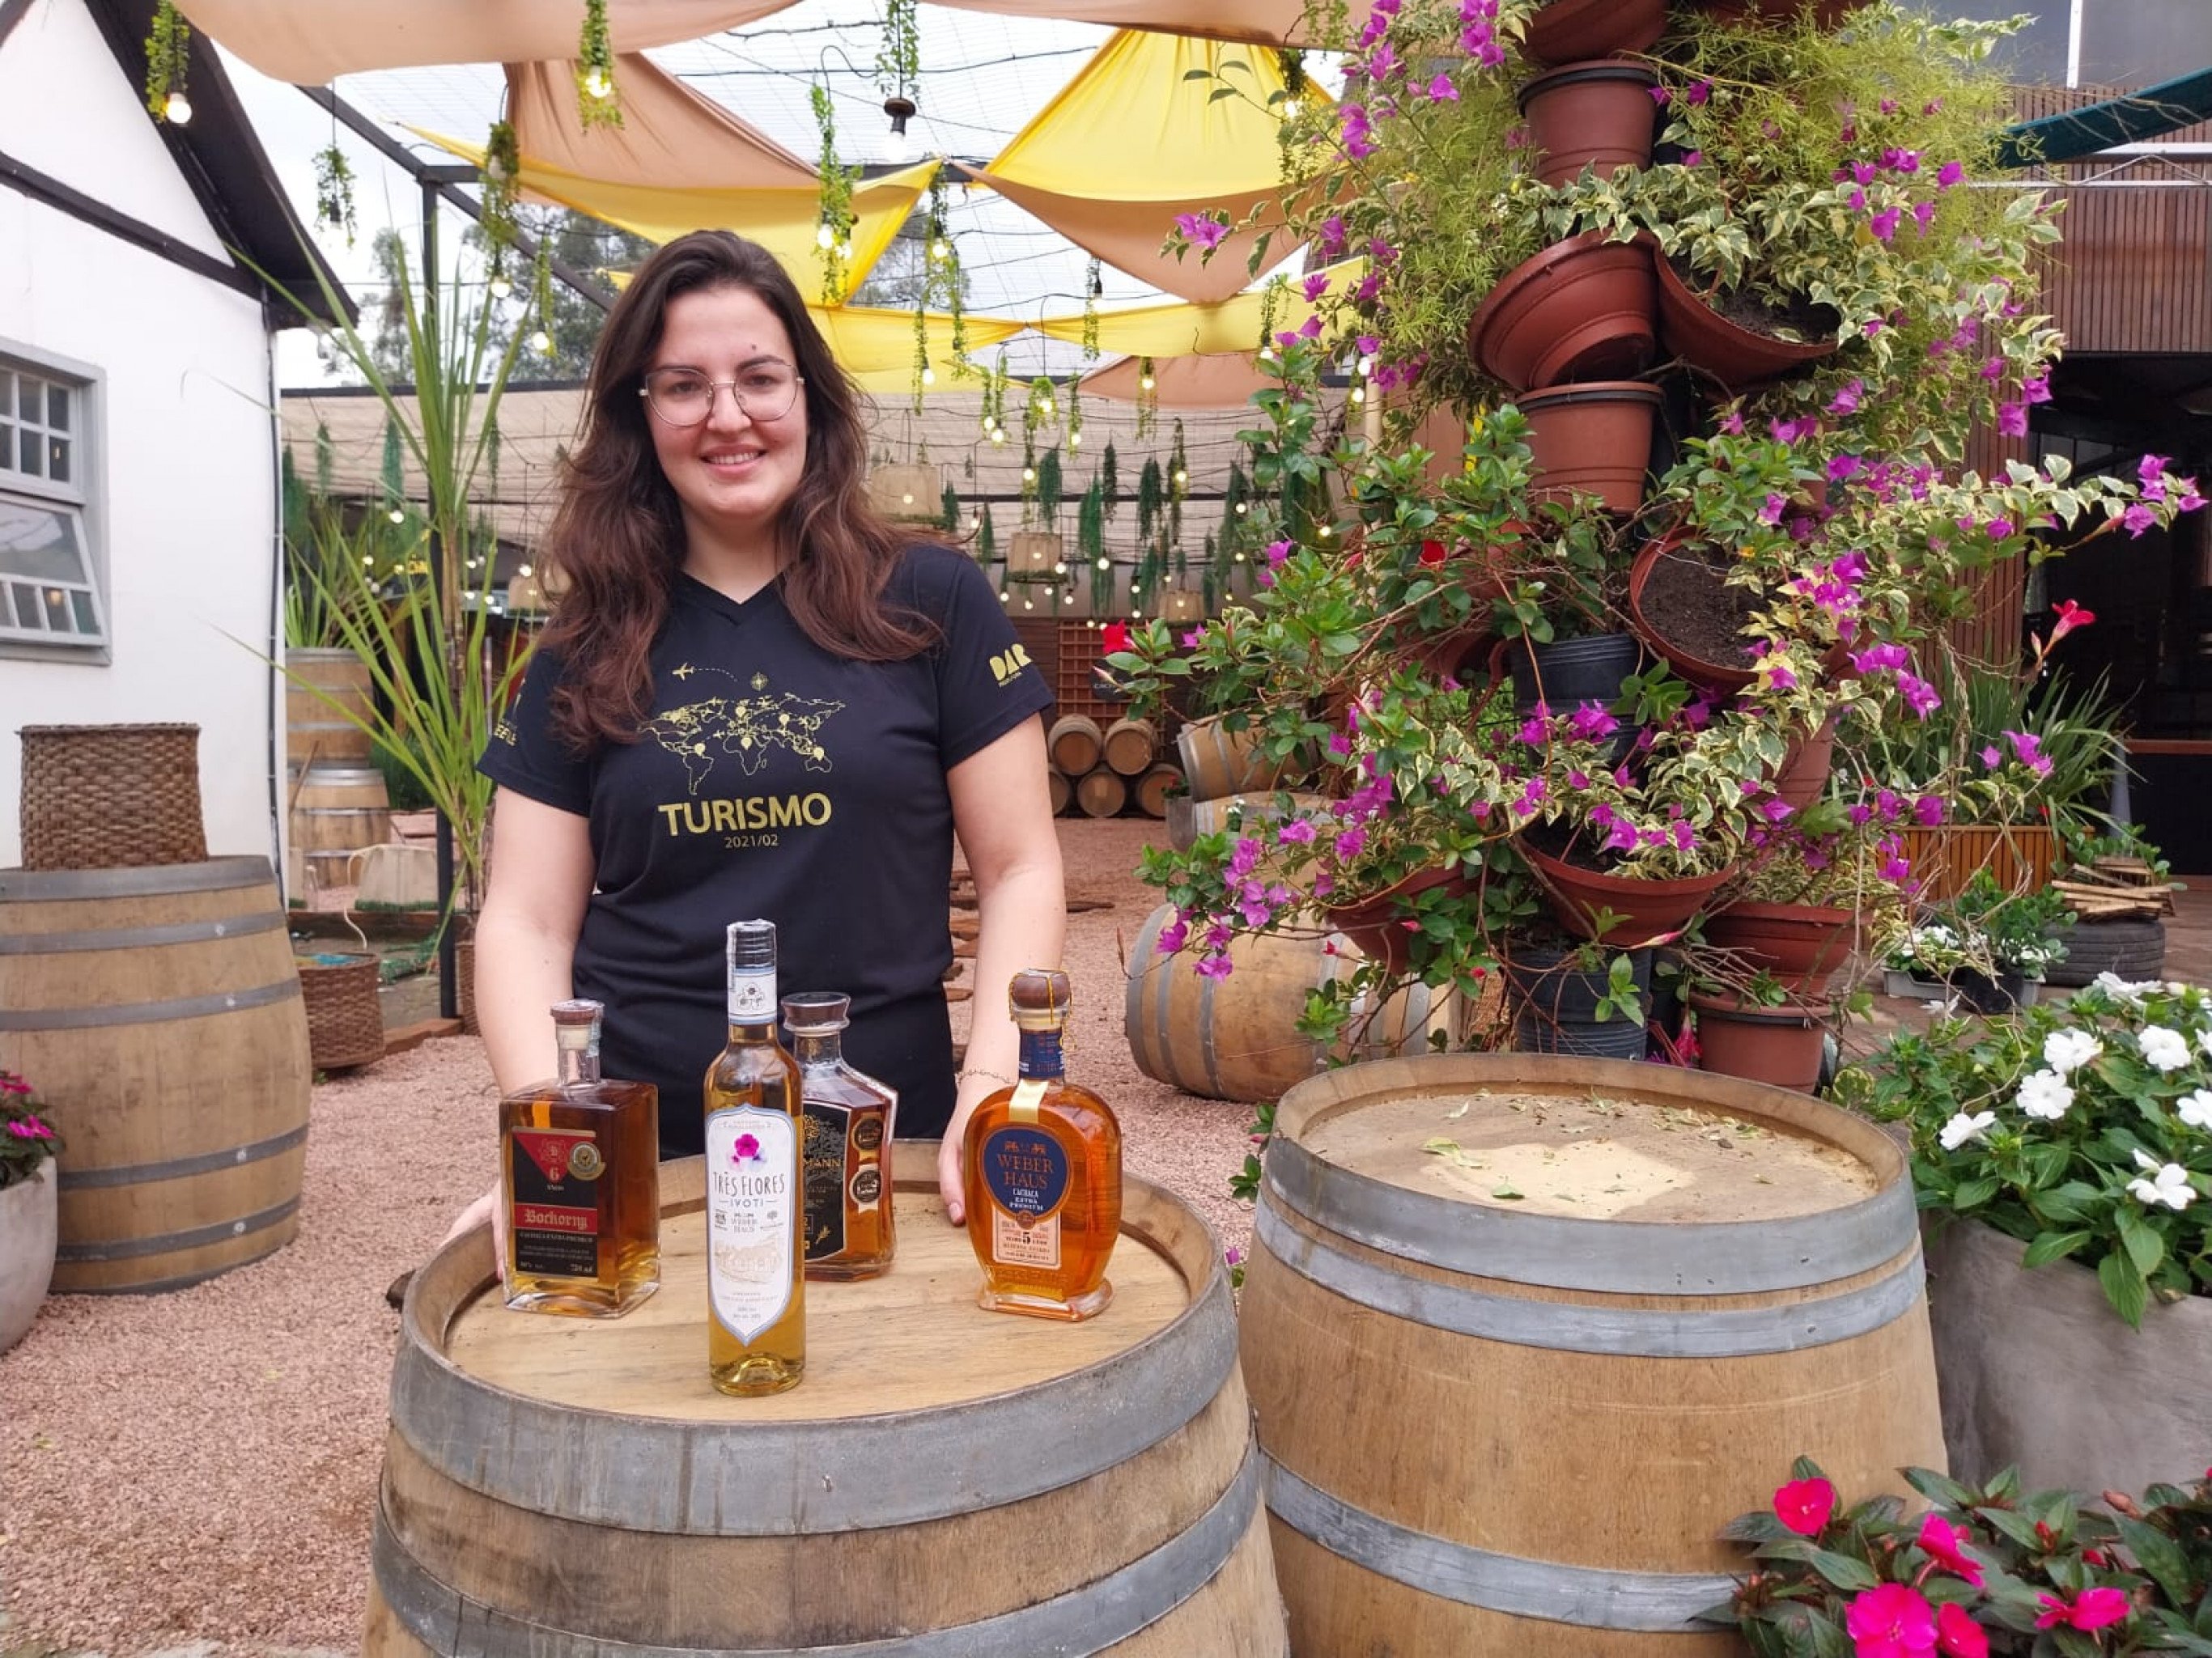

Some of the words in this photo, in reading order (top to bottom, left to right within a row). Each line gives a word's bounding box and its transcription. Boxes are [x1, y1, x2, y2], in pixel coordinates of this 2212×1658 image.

[657, 792, 833, 837] TURISMO
[724, 834, 779, 849] 2021/02
[997, 1153, 1053, 1173] WEBER
[550, 1167, 560, 1181] 6
[1003, 1171, 1048, 1189] HAUS
[713, 1171, 738, 1197] TRÊS
[741, 1172, 785, 1196] FLORES
[730, 1198, 764, 1208] IVOTI
[1022, 1232, 1031, 1245] 5
